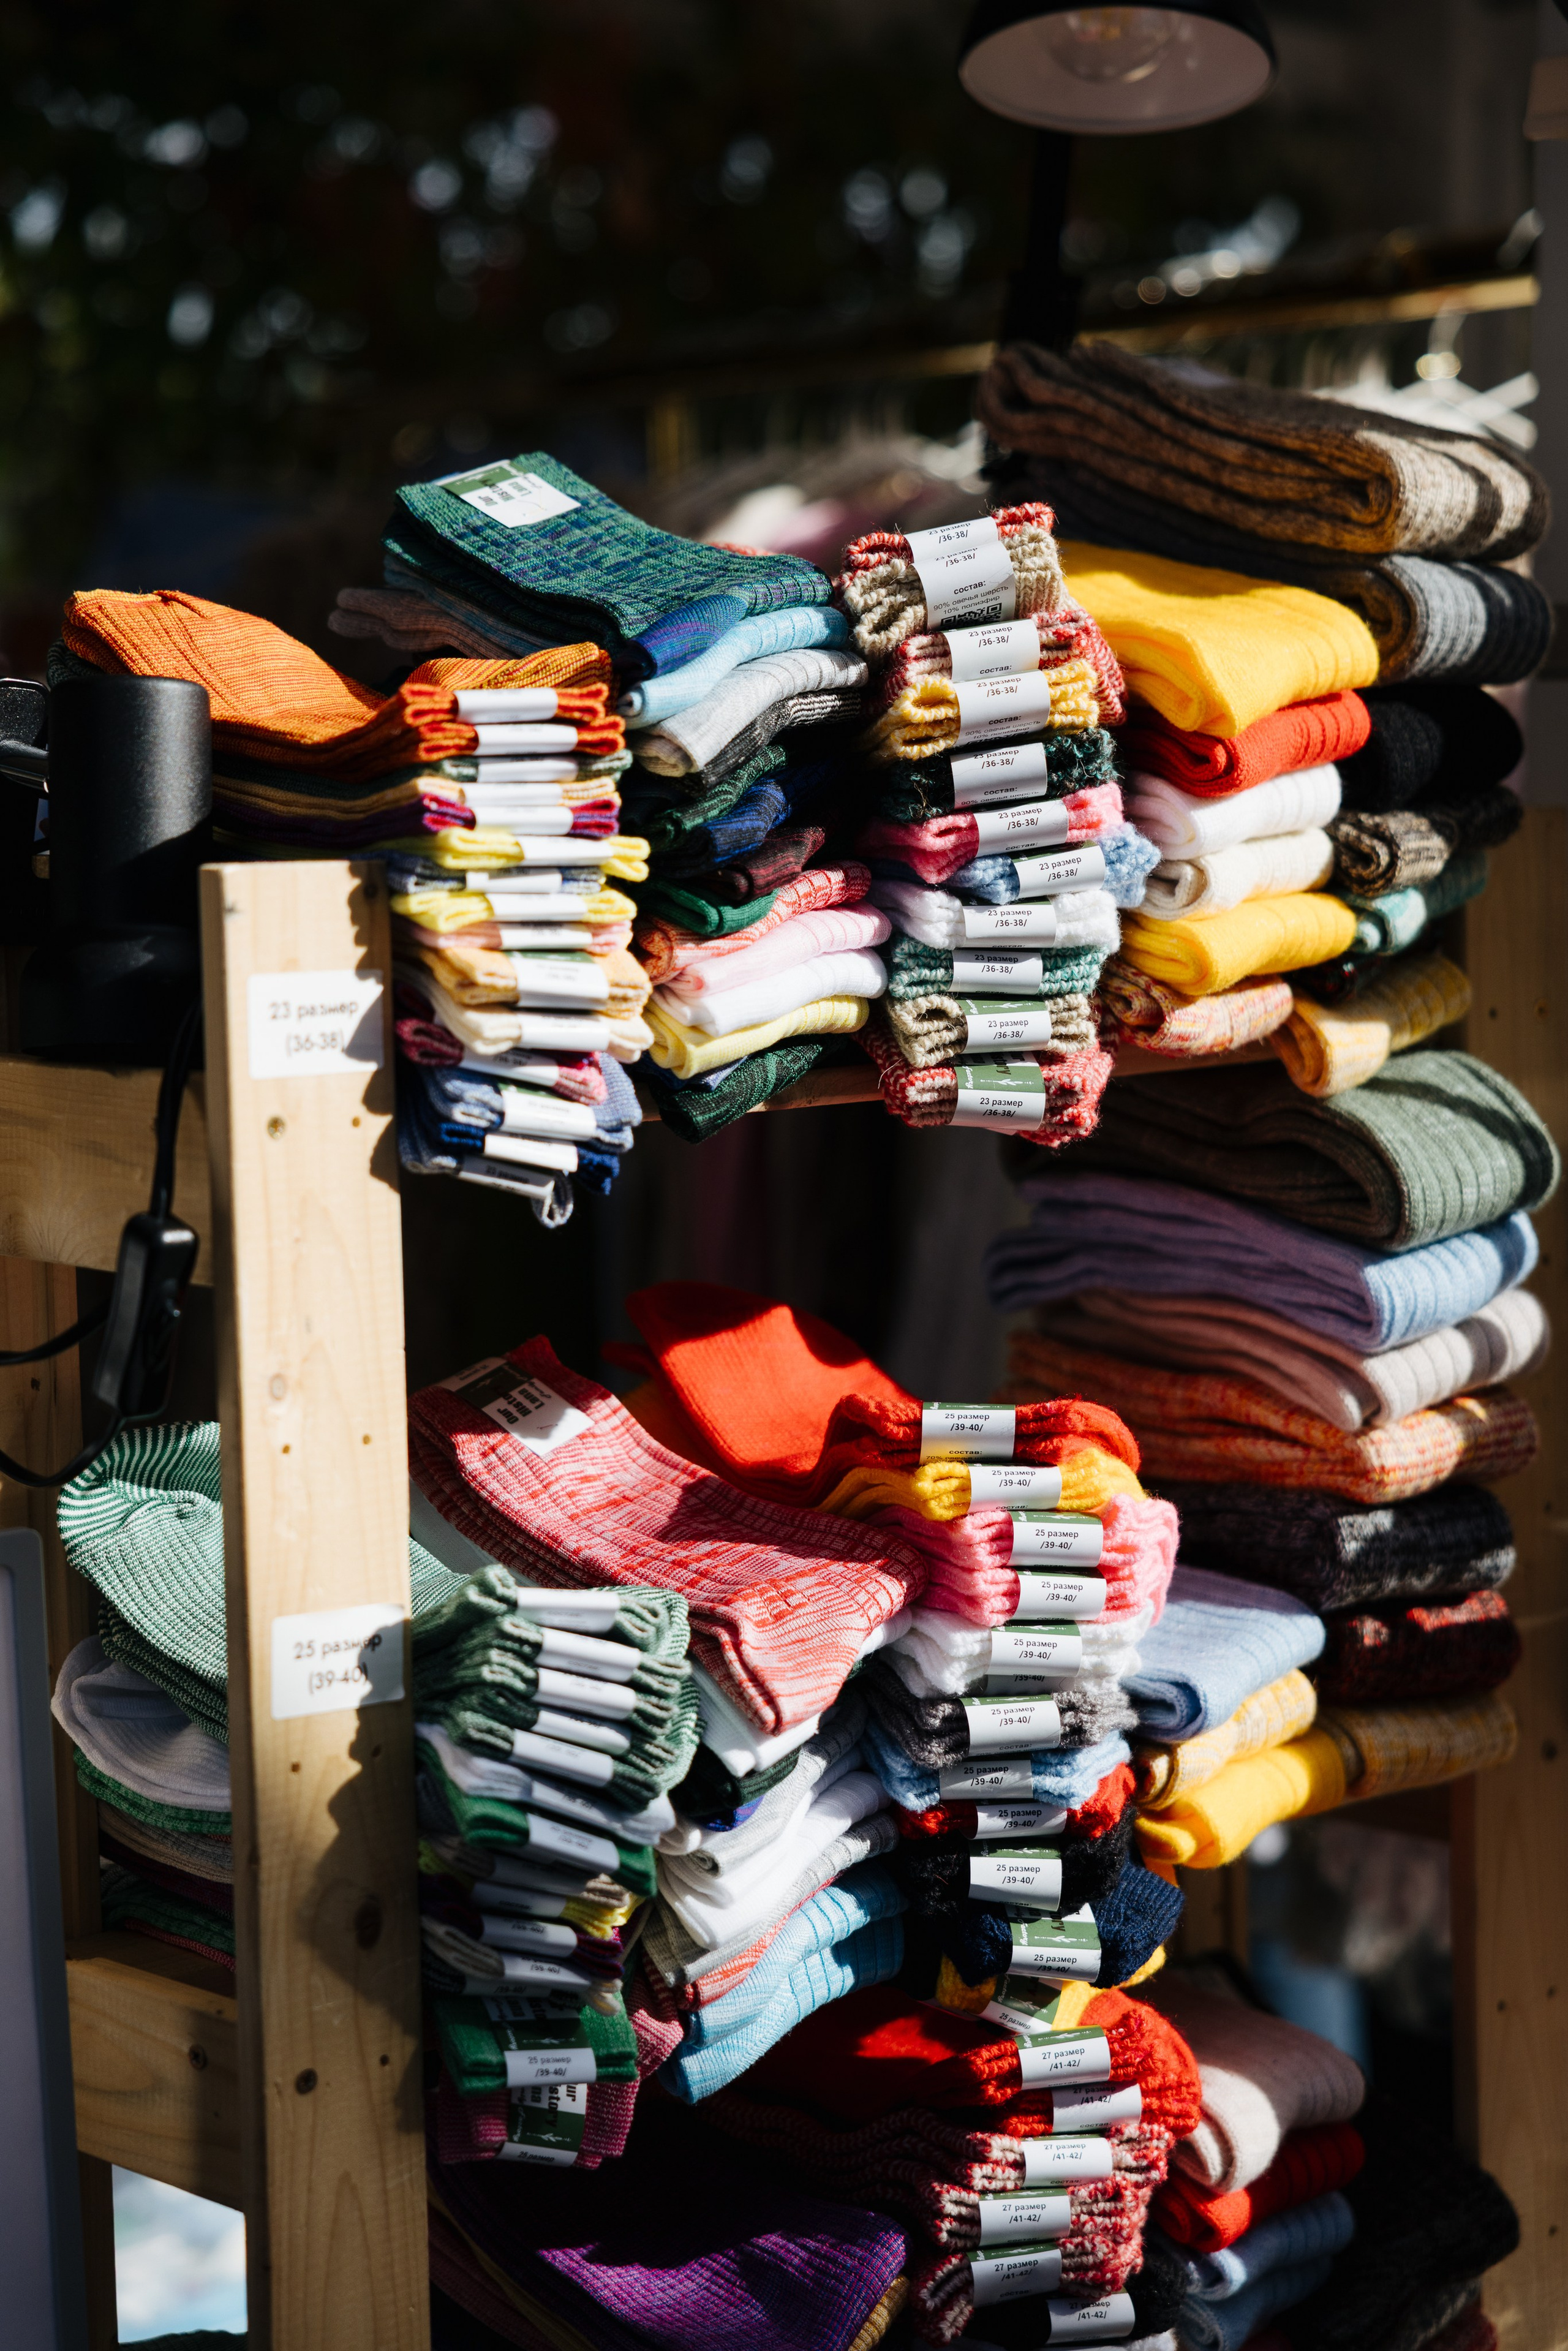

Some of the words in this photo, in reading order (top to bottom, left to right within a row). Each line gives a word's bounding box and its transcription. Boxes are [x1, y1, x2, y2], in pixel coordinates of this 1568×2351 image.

[940, 523, 970, 533] размер
[939, 530, 968, 543] /36-38/
[947, 547, 978, 557] размер
[946, 553, 975, 567] /36-38/
[954, 581, 986, 594] состав:
[933, 602, 949, 610] 90%
[952, 594, 978, 605] овечья
[981, 586, 1008, 597] шерсть
[962, 595, 1000, 609] полиэфир
[981, 626, 1012, 636] размер
[979, 635, 1009, 647] /36-38/
[980, 665, 1012, 674] состав:
[989, 677, 1021, 686] размер
[987, 685, 1018, 697] /36-38/
[989, 715, 1022, 725] состав:
[987, 750, 1019, 758] размер
[981, 758, 1014, 769] /36-38/
[1011, 808, 1042, 818] размер
[1008, 818, 1039, 830] /36-38/
[1051, 857, 1082, 869] размер
[1048, 868, 1078, 881] /36-38/
[981, 965, 1013, 974] /36-38/
[270, 1002, 291, 1021] 23
[297, 1000, 359, 1021] размер
[1000, 1020, 1028, 1028] размер
[993, 1031, 1023, 1040] /36-38/
[286, 1028, 345, 1057] (36-38)
[990, 1052, 1011, 1075] story
[518, 1388, 545, 1409] Lana
[497, 1408, 519, 1424] Our
[1046, 1593, 1077, 1602] /39-40/
[293, 1640, 315, 1659] 25
[322, 1634, 382, 1658] размер
[1026, 1640, 1057, 1649] размер
[1019, 1651, 1052, 1659] /39-40/
[309, 1662, 369, 1694] (39-40)
[1004, 1706, 1035, 1715] размер
[1000, 1716, 1031, 1727] /39-40/
[977, 1766, 1009, 1775] размер
[971, 1777, 1003, 1786] /39-40/
[1011, 1809, 1042, 1818] размер
[1002, 1876, 1035, 1885] /39-40/
[1007, 2016, 1031, 2029] размер
[1054, 2048, 1085, 2059] размер
[1049, 2059, 1080, 2071] /41-42/
[535, 2067, 567, 2077] /39-40/
[566, 2085, 576, 2102] ur
[545, 2085, 561, 2127] istory
[1081, 2096, 1111, 2105] /41-42/
[1009, 2214, 1041, 2224] /41-42/
[1007, 2260, 1038, 2271] размер
[1001, 2269, 1032, 2281] /41-42/
[1077, 2311, 1107, 2321] /41-42/
